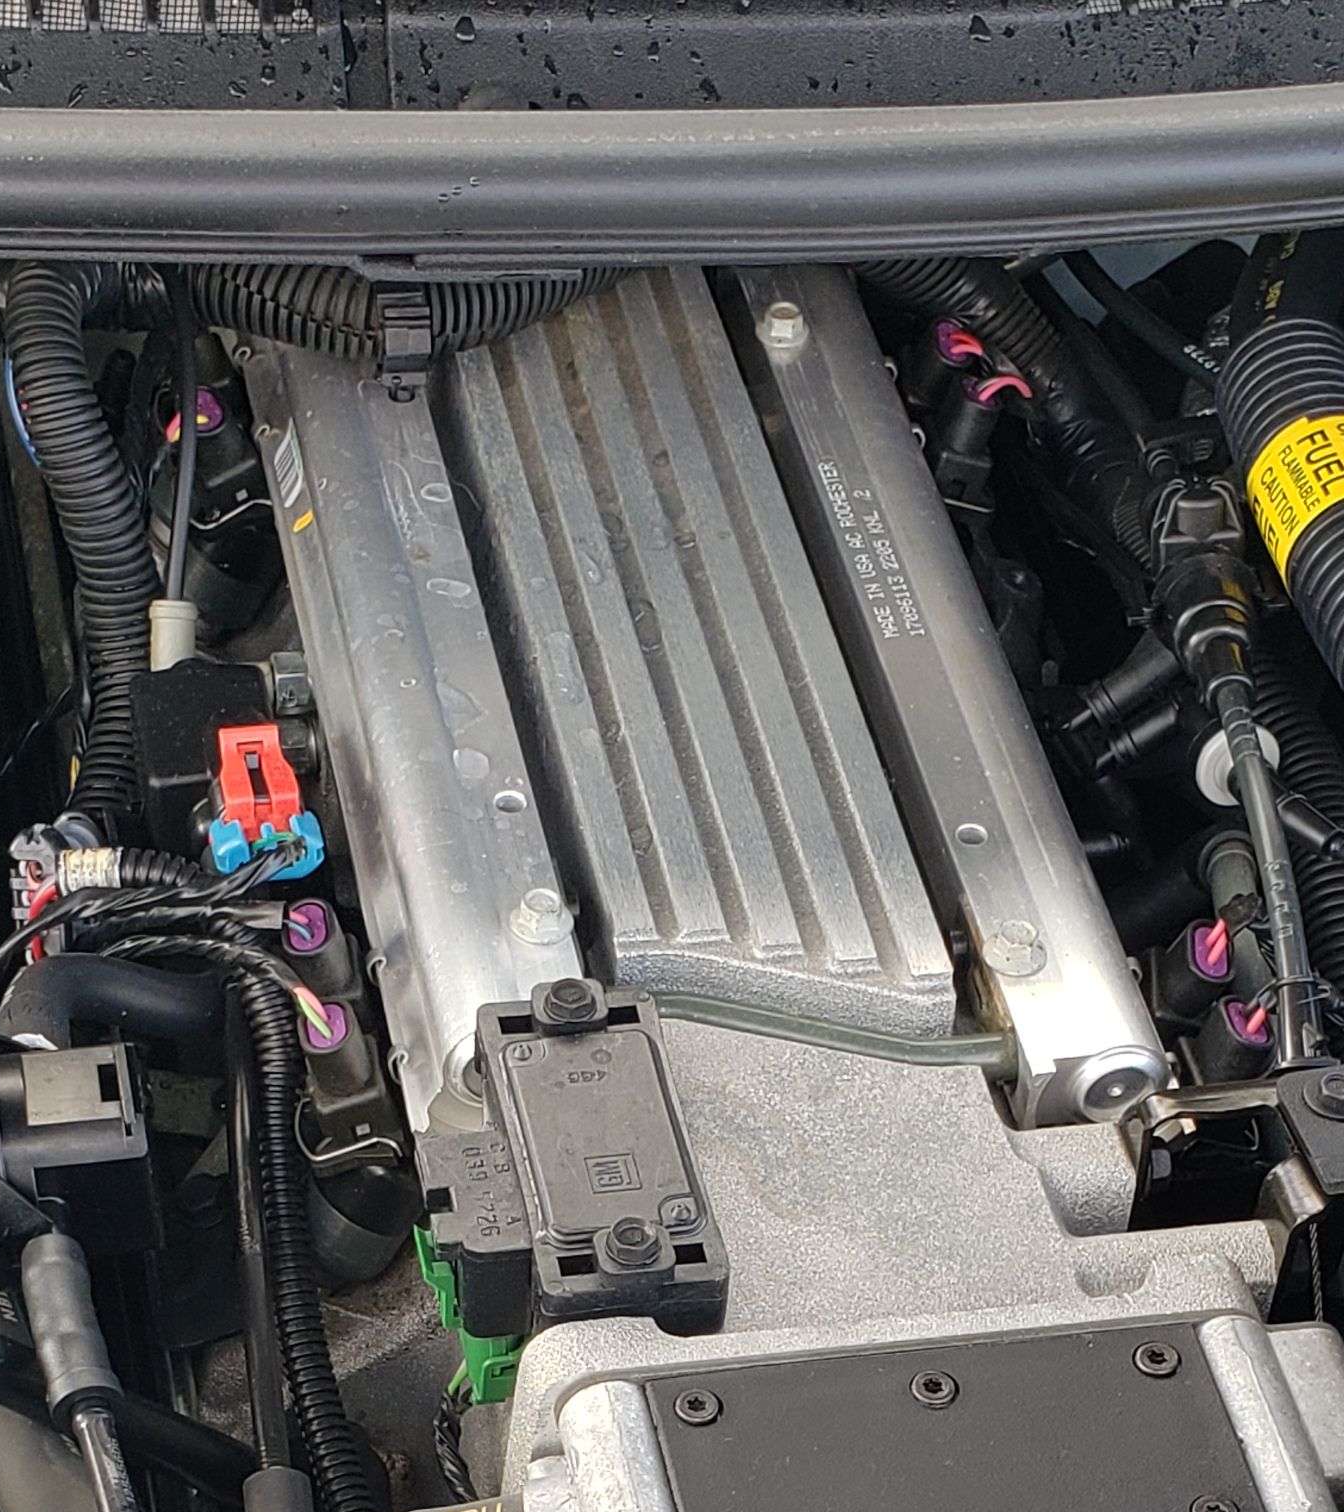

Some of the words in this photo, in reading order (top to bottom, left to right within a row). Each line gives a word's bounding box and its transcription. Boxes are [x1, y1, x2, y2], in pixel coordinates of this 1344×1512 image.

[818, 461, 857, 528] ROCHESTER
[1278, 444, 1321, 513] FLAMMABLE
[1261, 467, 1301, 537] CAUTION
[845, 532, 865, 549] AC
[854, 553, 876, 579] USA
[864, 583, 885, 601] IN
[874, 605, 900, 639] MADE
